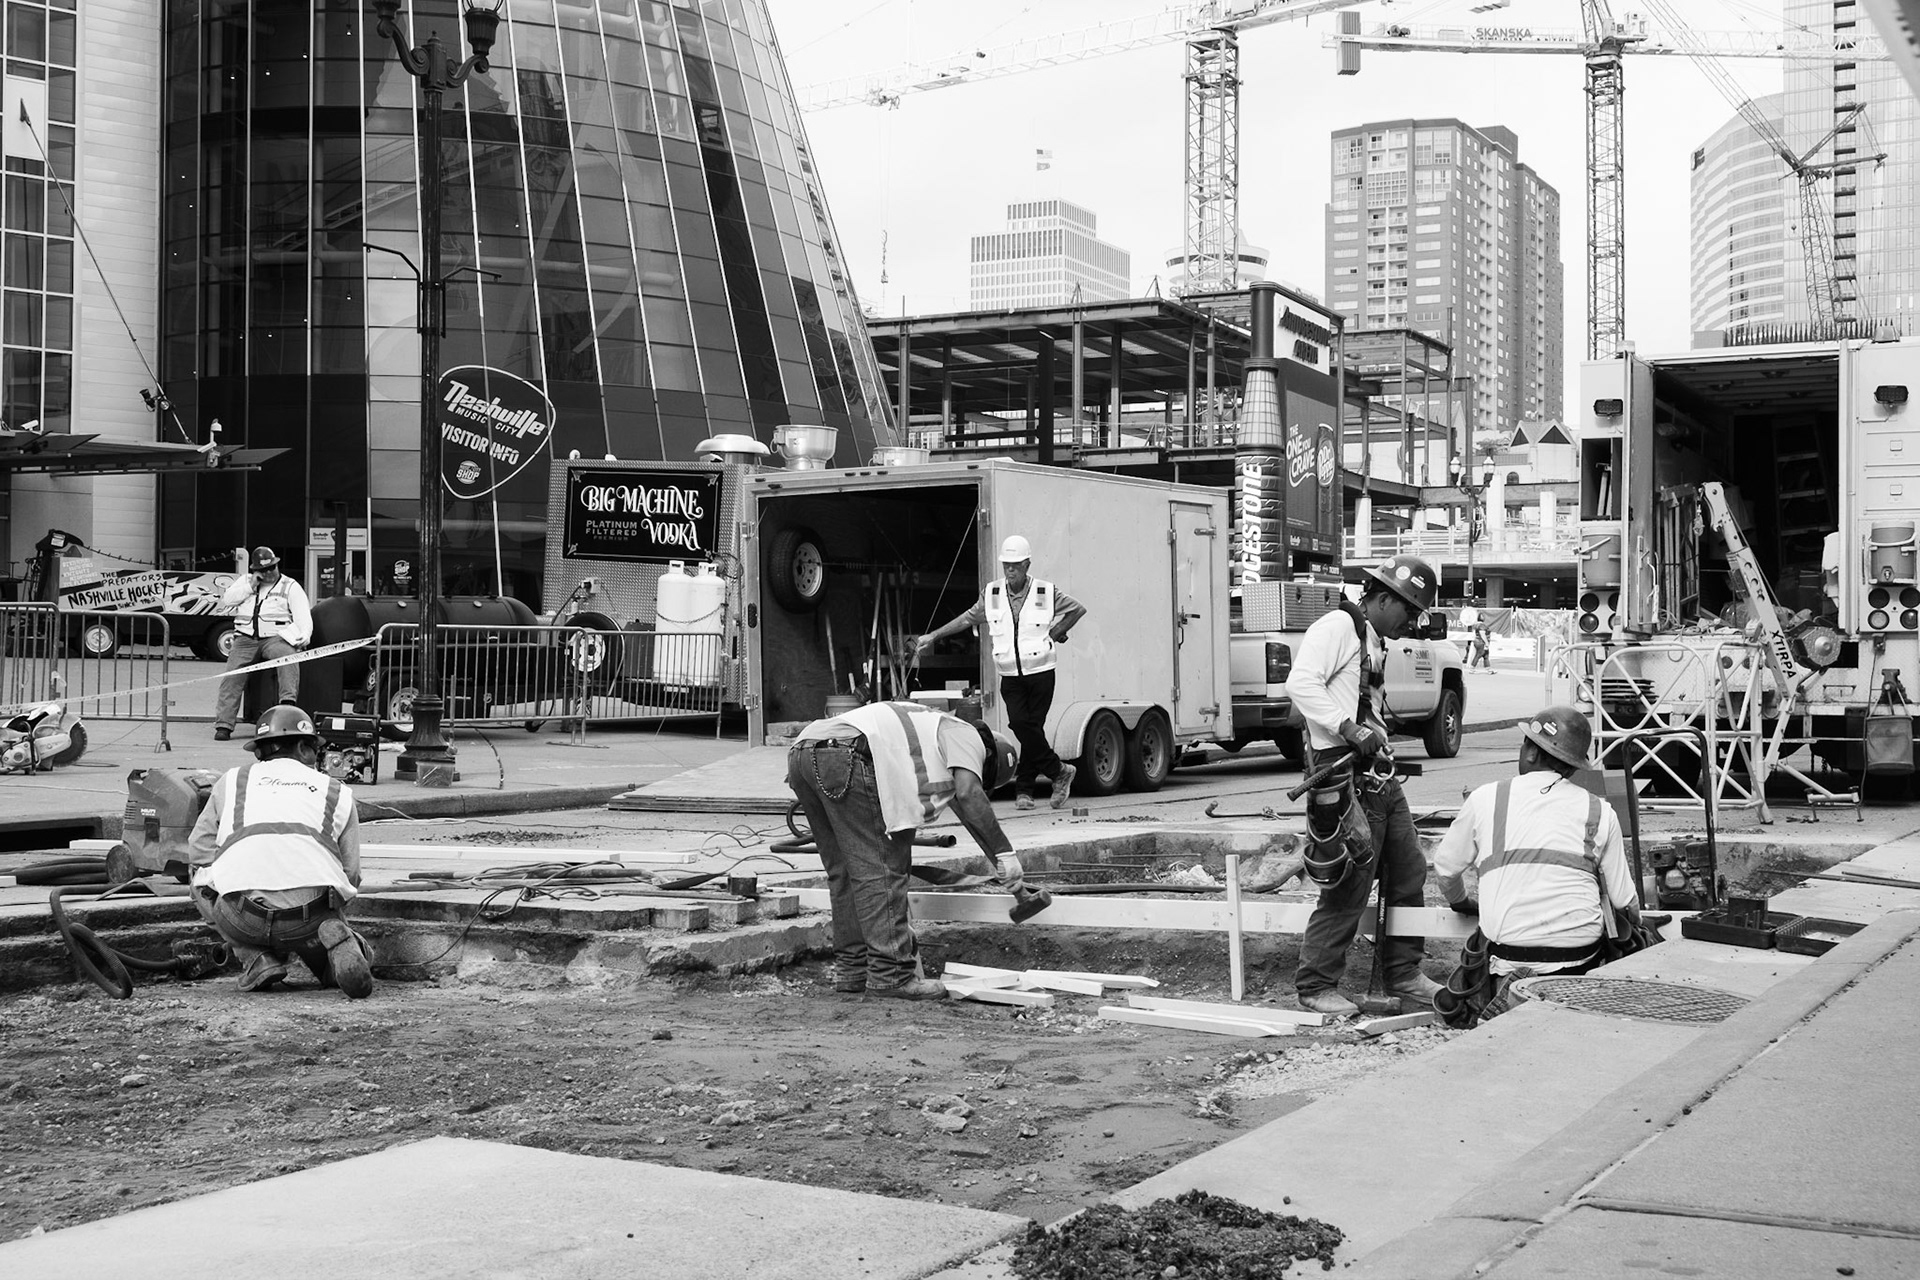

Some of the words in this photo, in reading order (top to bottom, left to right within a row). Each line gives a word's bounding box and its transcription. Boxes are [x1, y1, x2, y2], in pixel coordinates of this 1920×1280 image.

[1476, 28, 1532, 38] SKANSKA
[443, 380, 546, 439] Nashville
[455, 407, 488, 424] MUSIC
[495, 422, 518, 435] CITY
[441, 423, 489, 453] VISITOR
[489, 442, 520, 465] INFO
[1289, 424, 1299, 438] THE
[1286, 434, 1303, 460] ONE
[456, 469, 480, 480] SHOP
[1292, 447, 1315, 478] CRAVE
[580, 485, 616, 512] BIG
[616, 485, 704, 520] MACHINE
[585, 528, 638, 537] FILTERED
[586, 519, 638, 529] PLATINUM
[641, 518, 701, 551] VODKA
[101, 573, 163, 587] PREDATORS
[67, 588, 125, 609] NASHVILLE
[127, 581, 174, 603] HOCKEY
[117, 601, 136, 610] SINCE
[1770, 630, 1797, 679] XTIRPA
